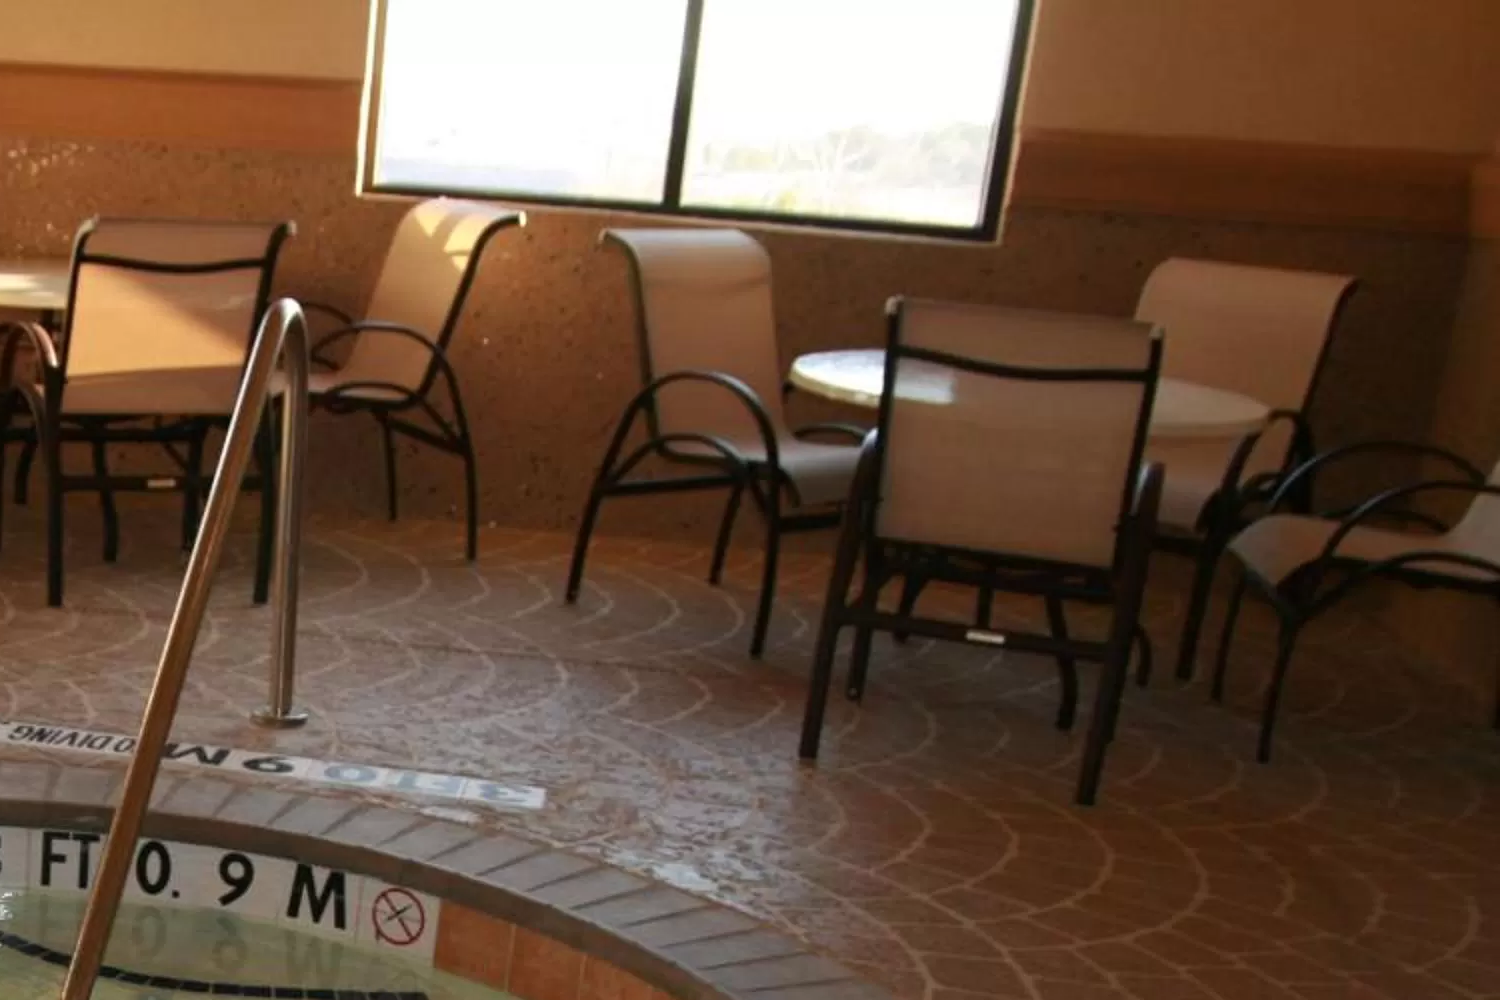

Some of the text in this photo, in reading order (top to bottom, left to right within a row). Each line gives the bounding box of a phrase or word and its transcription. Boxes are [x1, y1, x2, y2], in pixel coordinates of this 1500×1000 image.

[8, 724, 113, 752] DIVING
[40, 831, 101, 889] FT
[286, 863, 347, 931] M
